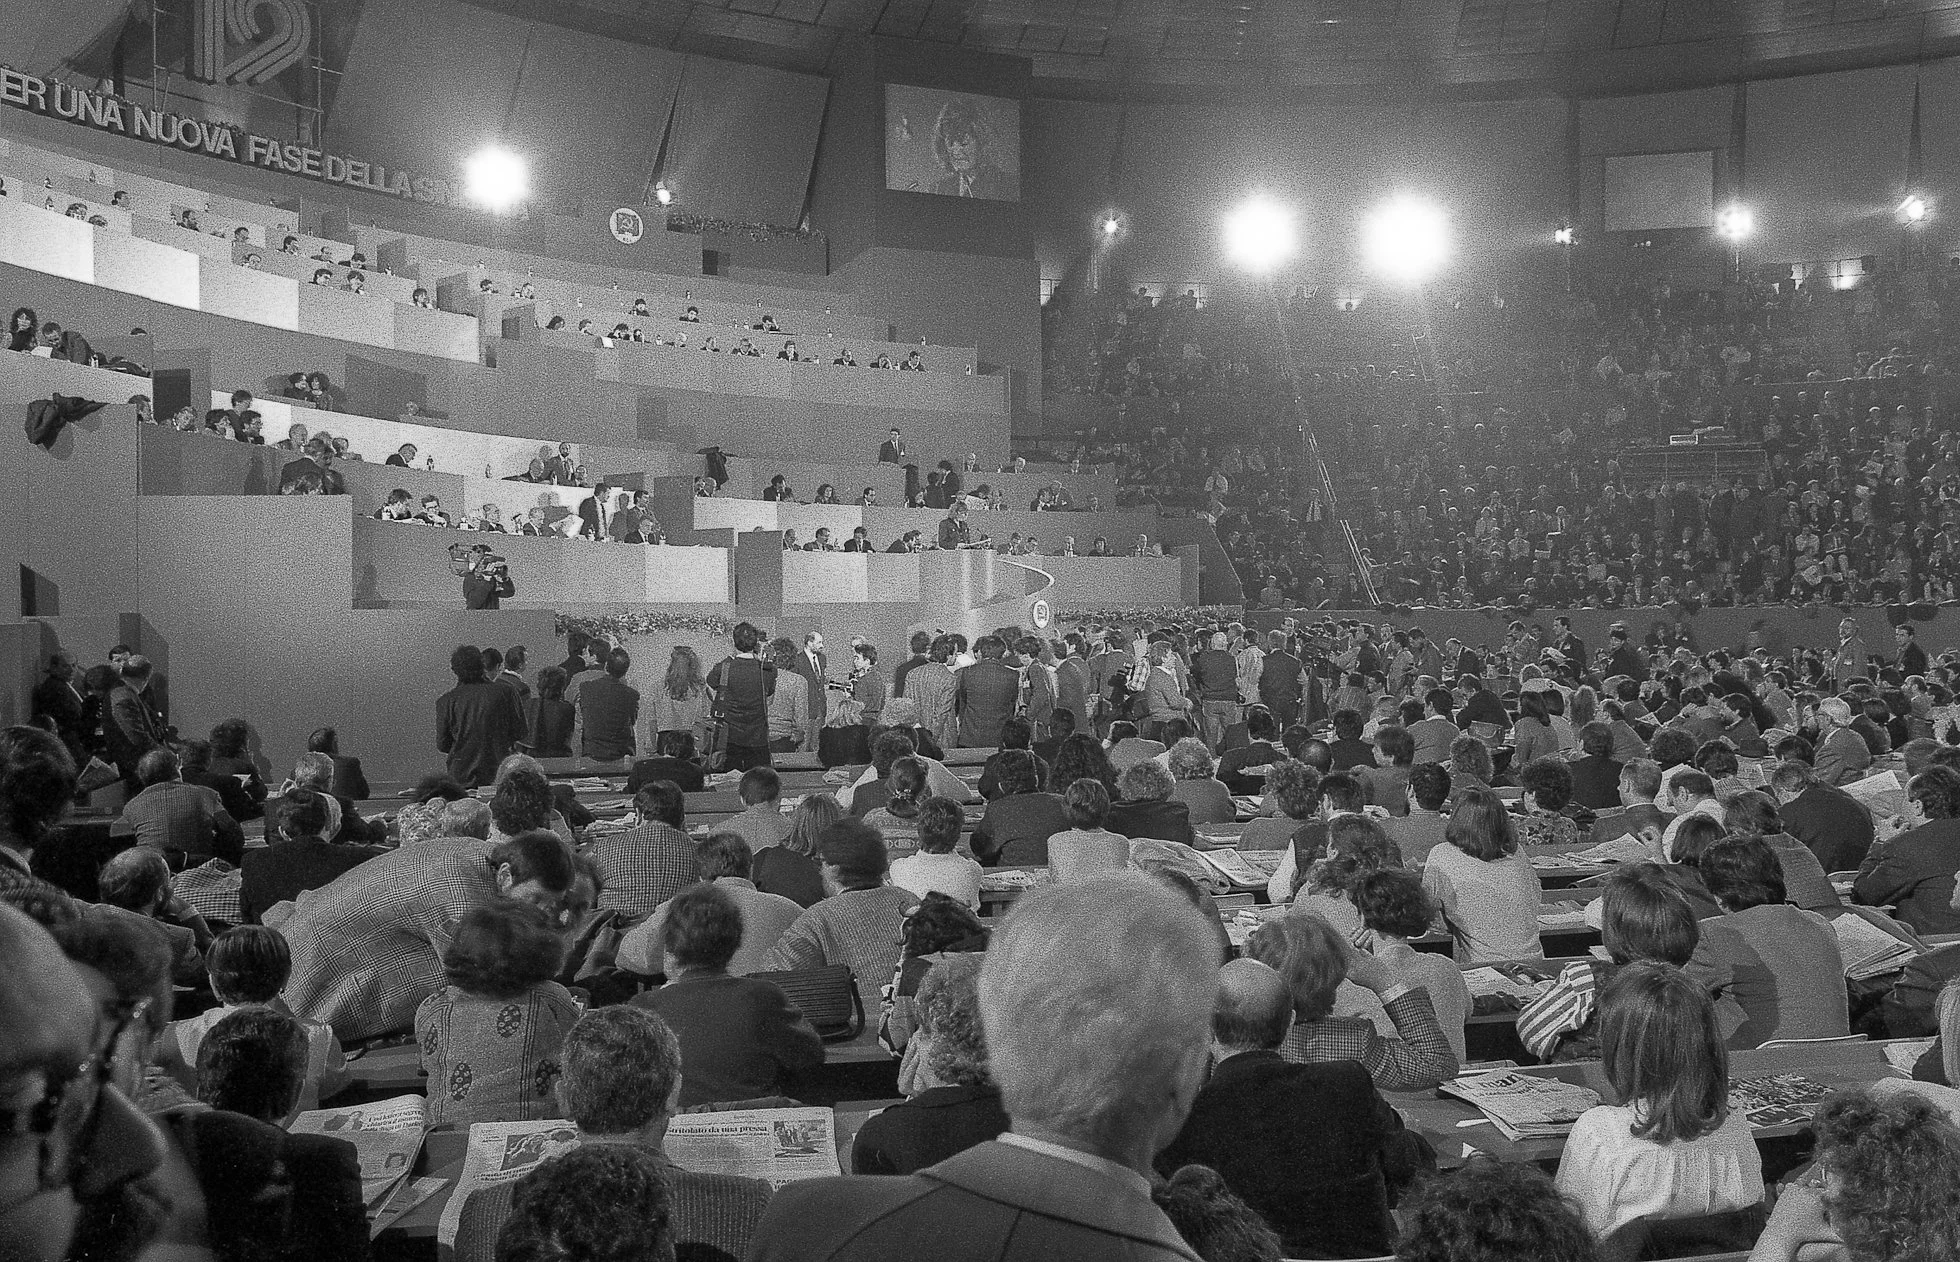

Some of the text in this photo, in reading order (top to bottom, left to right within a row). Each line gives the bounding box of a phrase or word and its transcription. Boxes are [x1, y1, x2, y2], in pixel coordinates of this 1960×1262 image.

[54, 83, 125, 131] UNA
[134, 106, 236, 158] NUOVA
[249, 135, 322, 177] FASE
[326, 155, 413, 198] DELLA
